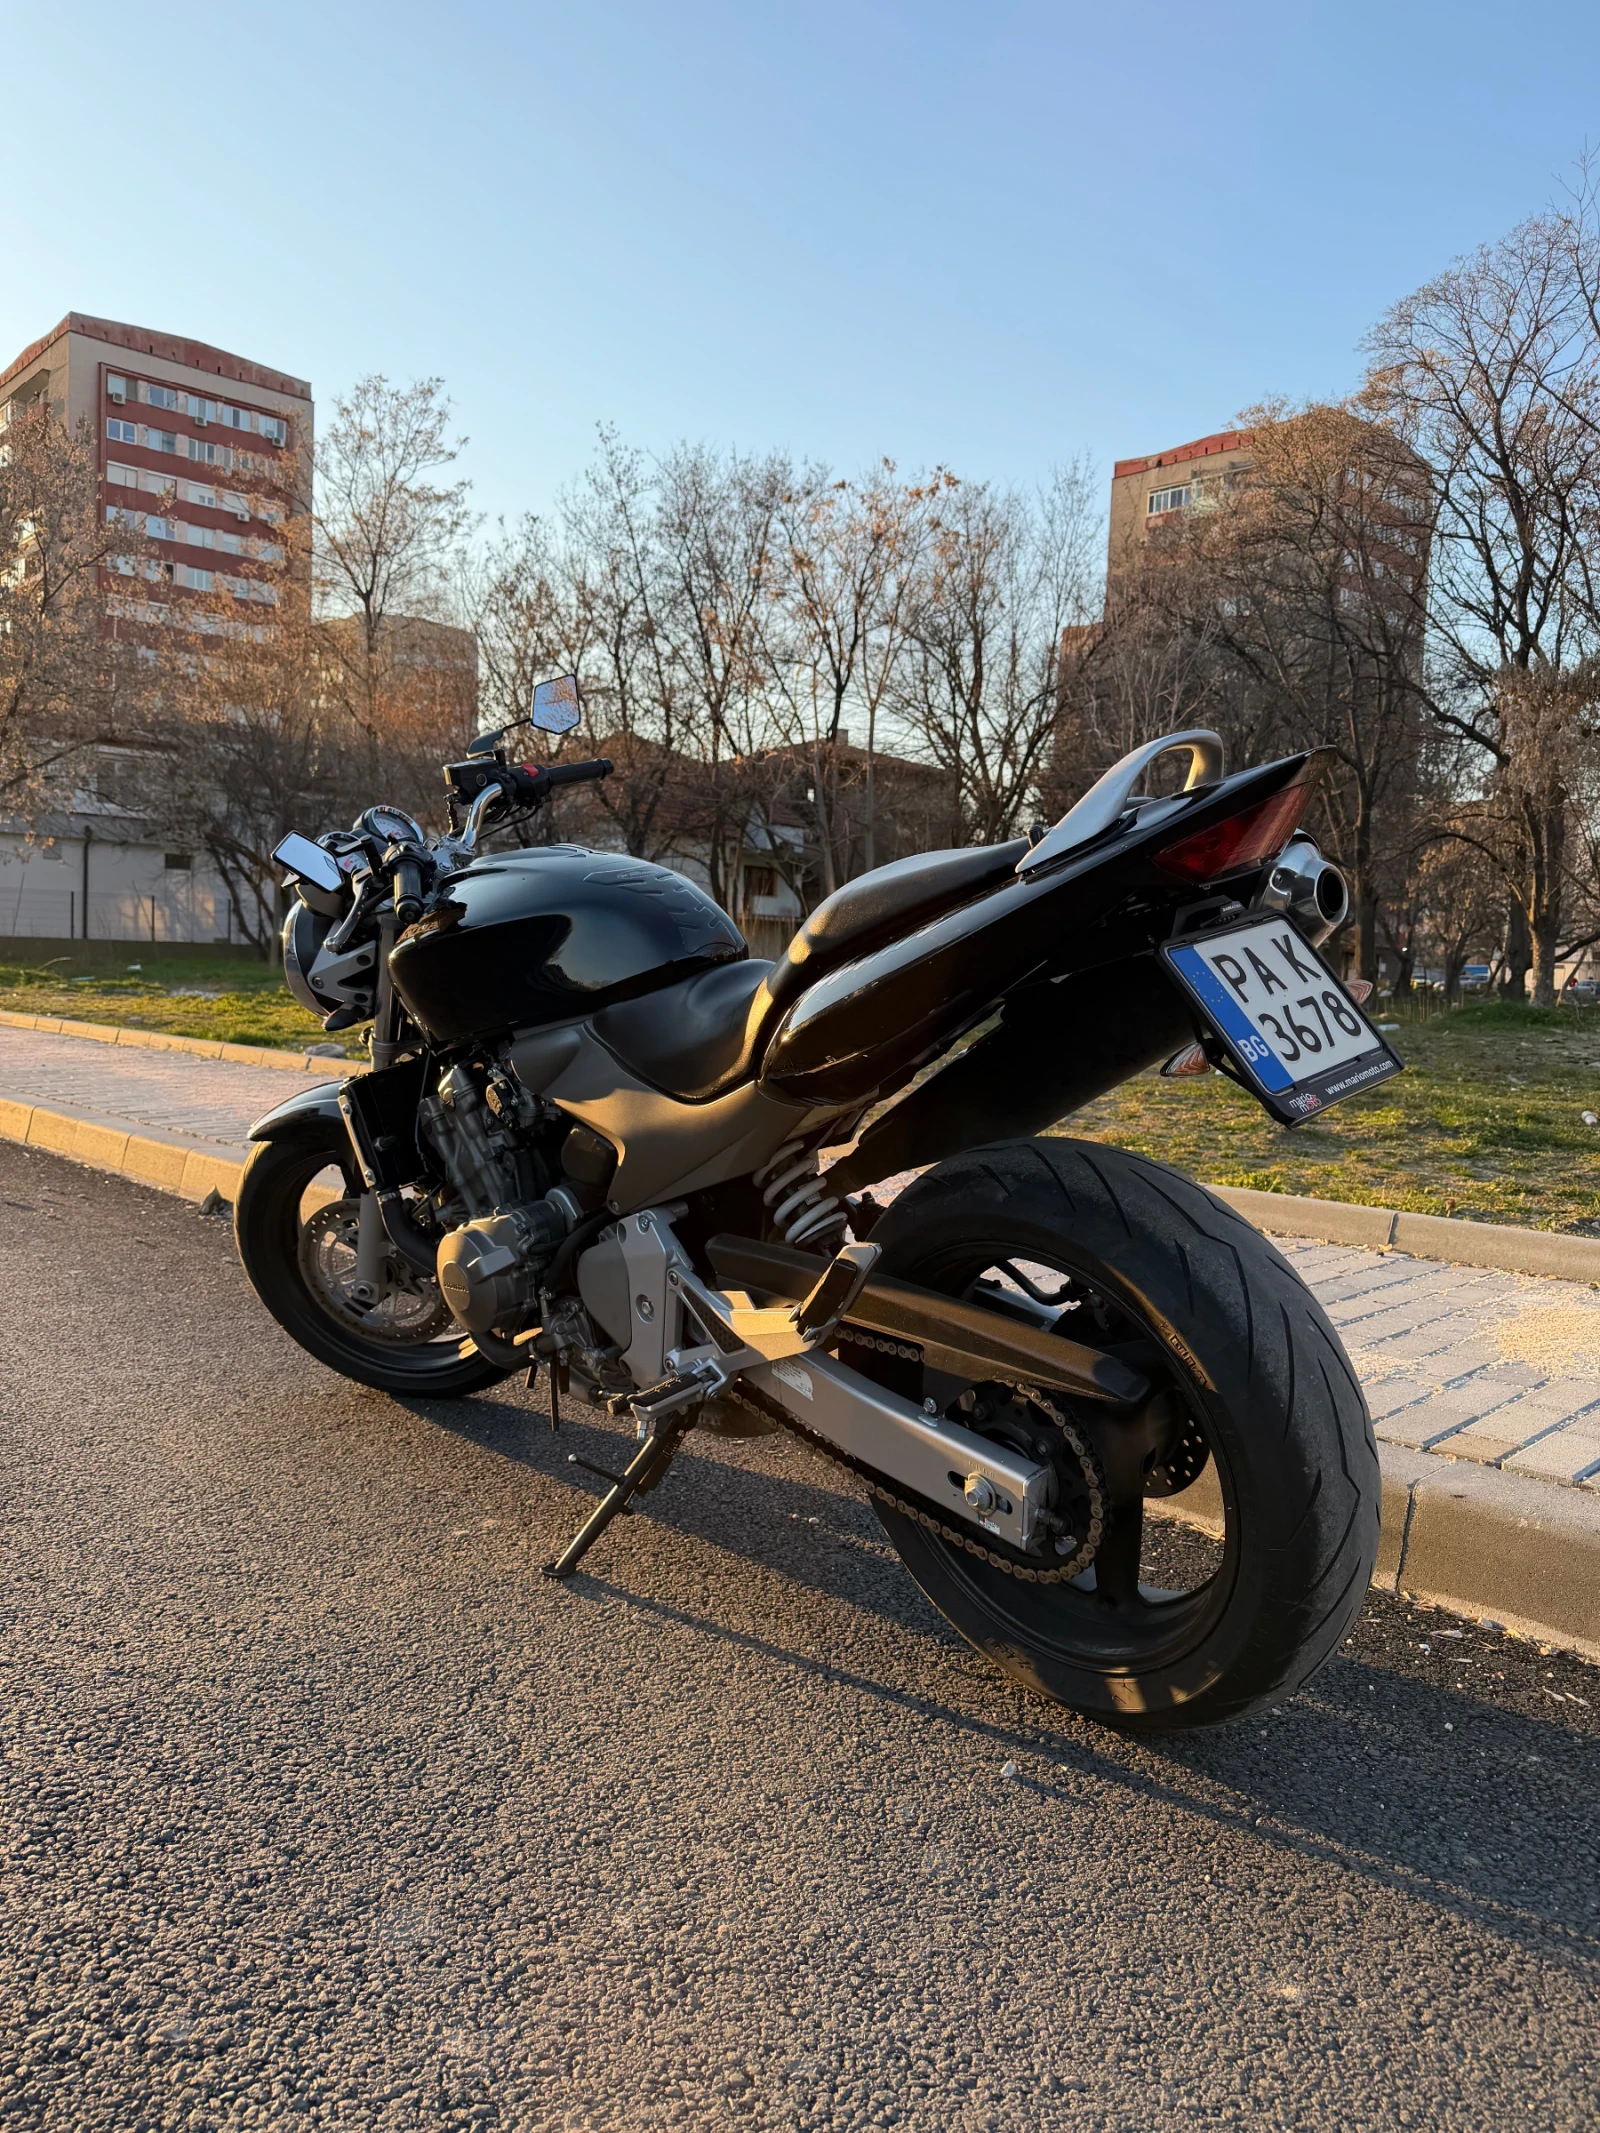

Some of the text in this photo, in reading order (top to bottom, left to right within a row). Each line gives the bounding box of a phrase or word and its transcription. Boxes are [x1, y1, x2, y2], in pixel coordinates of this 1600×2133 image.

[1257, 990, 1362, 1062] 3678
[1237, 1035, 1269, 1063] BG
[1325, 1060, 1394, 1095] www.mariomoto.com
[1288, 1092, 1313, 1108] mario
